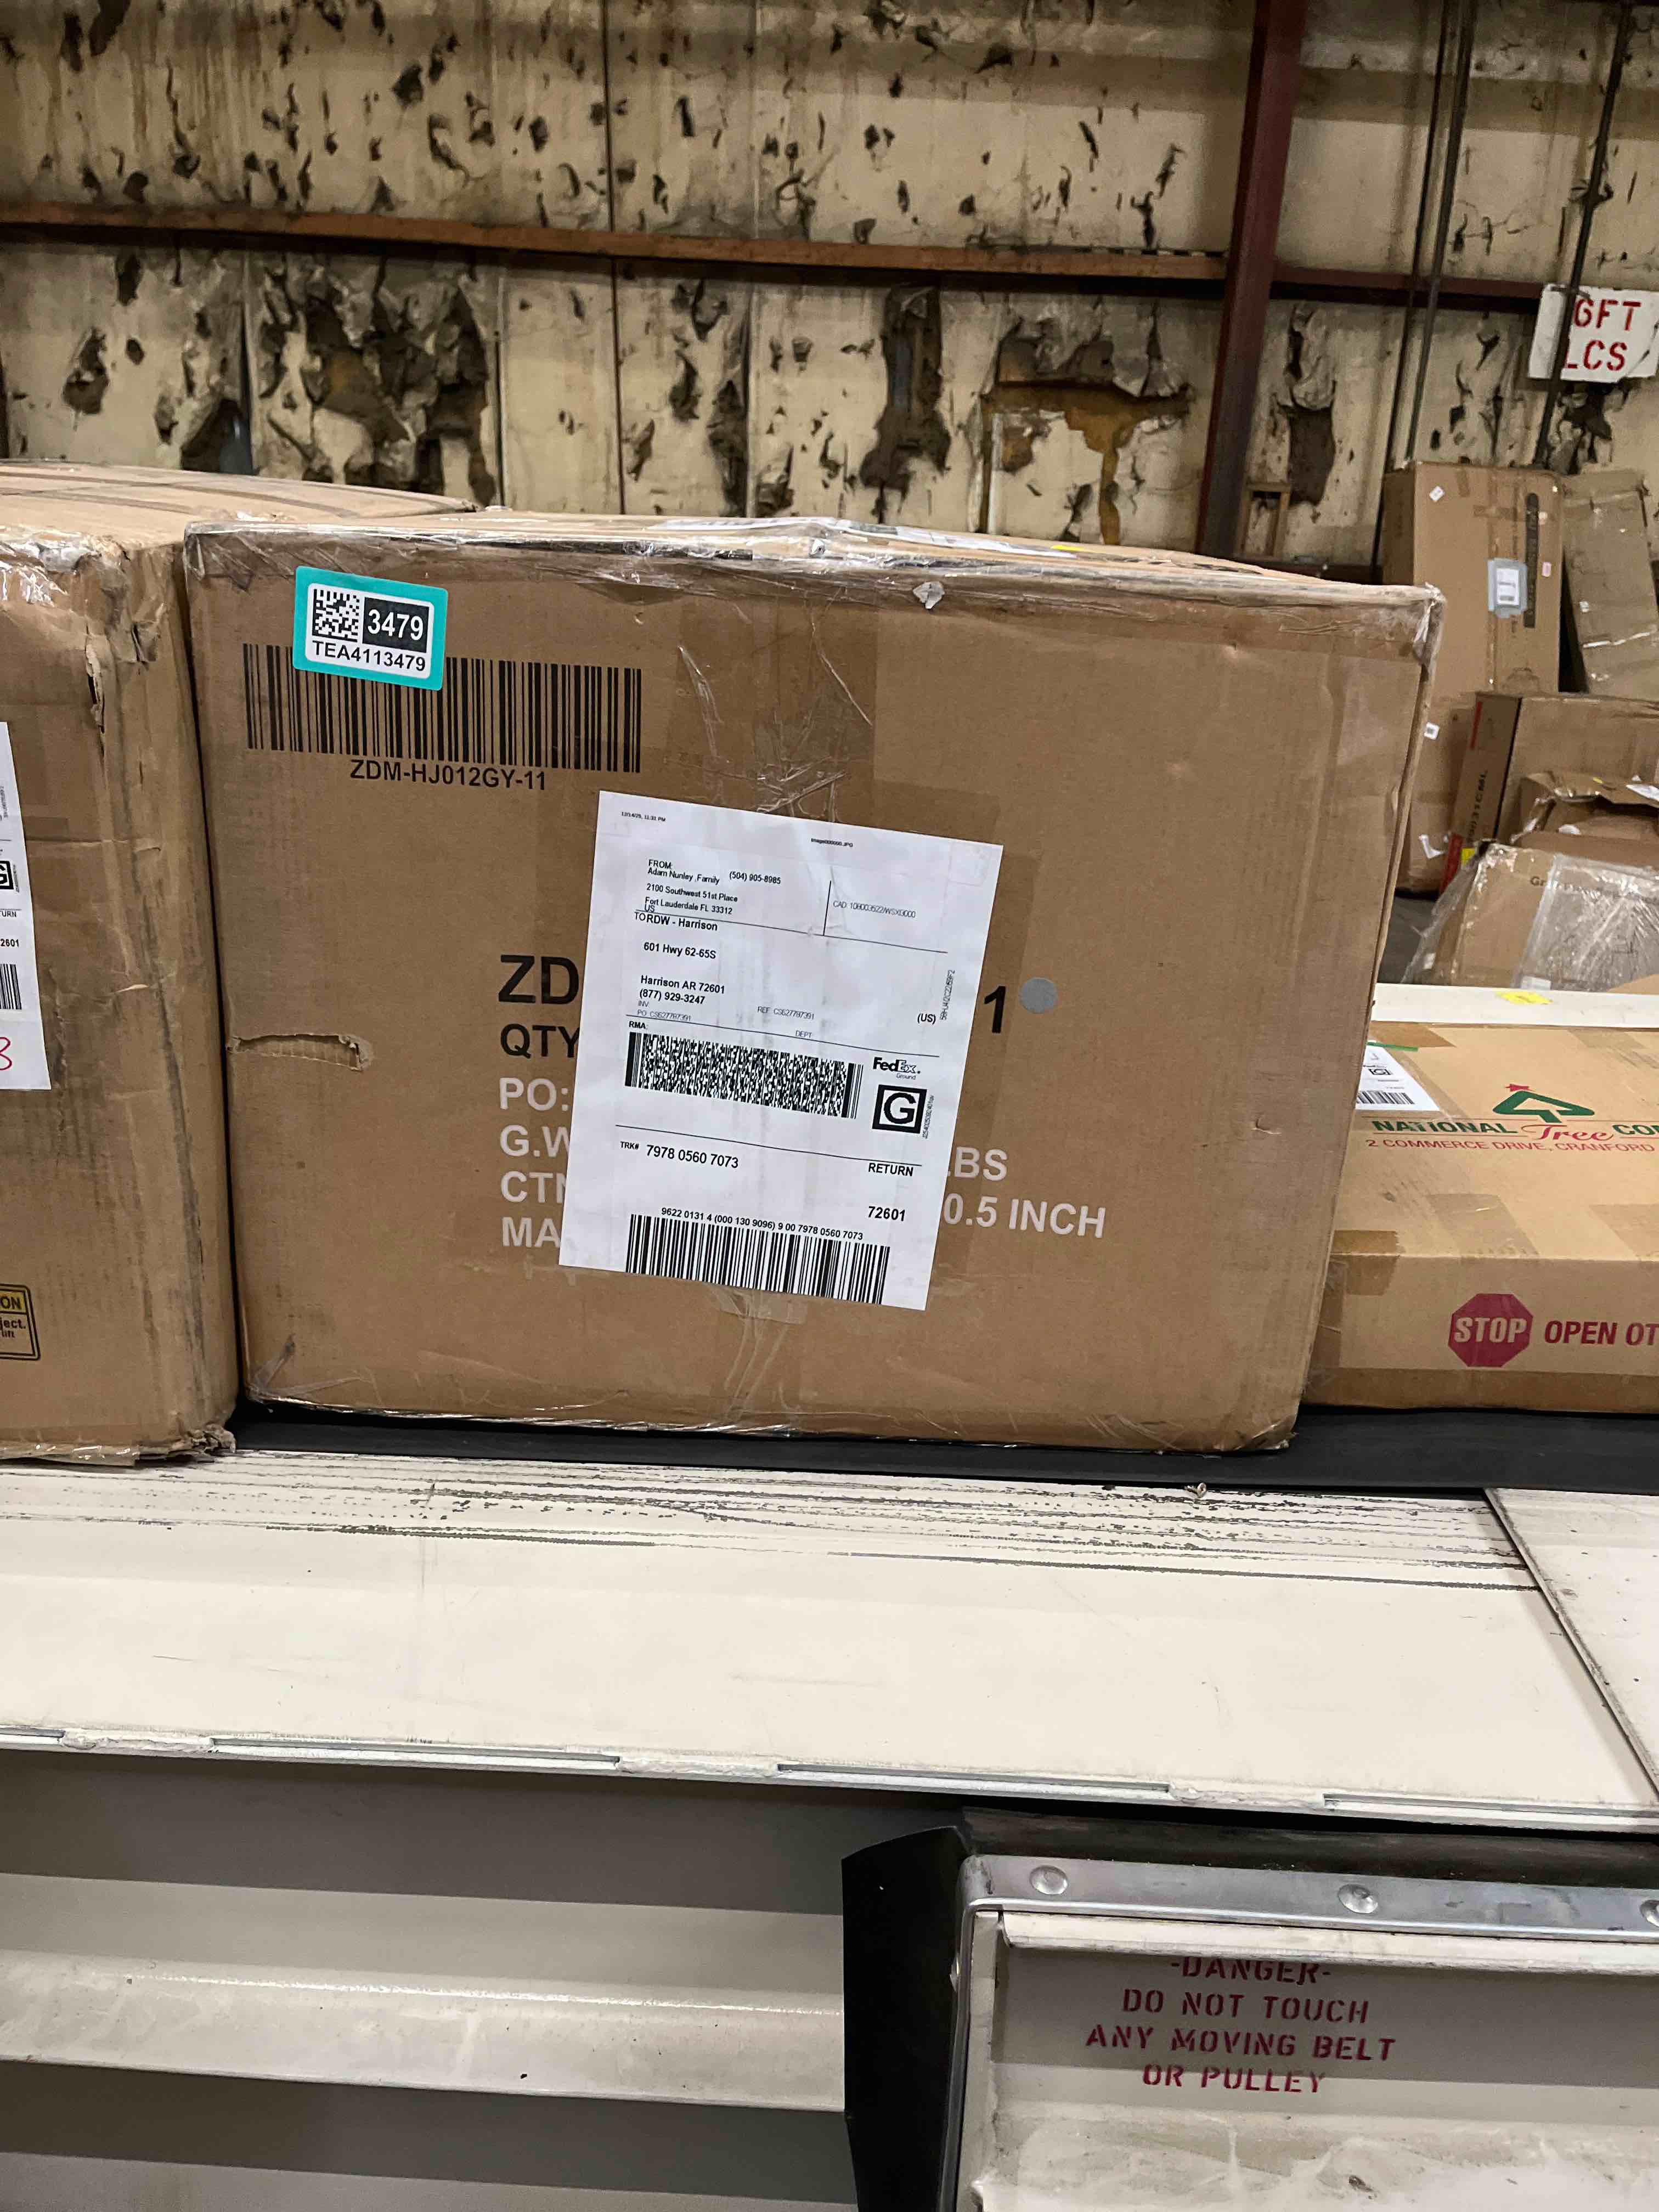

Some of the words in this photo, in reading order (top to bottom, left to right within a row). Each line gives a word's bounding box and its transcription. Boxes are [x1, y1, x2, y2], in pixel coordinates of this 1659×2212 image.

[368, 608, 425, 641] 3479
[313, 640, 426, 672] TEA4113479
[349, 759, 545, 791] ZDM-HJ012GY-11
[648, 867, 667, 877] Adam
[669, 871, 693, 882] Nunley
[729, 871, 747, 881] (504)
[749, 873, 781, 884] 905-8985
[646, 883, 663, 892] 2100
[665, 886, 701, 898] Southwest
[702, 891, 717, 900] 51st
[719, 893, 738, 902] Place
[644, 904, 655, 913] US
[645, 896, 659, 905] Fort
[661, 899, 698, 911] Lauderdale
[711, 905, 733, 915] 33312
[678, 918, 718, 931] Harrison
[644, 942, 659, 951] 601
[663, 944, 683, 957] Hwy
[685, 947, 716, 959] 62-65S
[641, 975, 679, 988] Harrison
[682, 980, 696, 990] AR
[699, 983, 725, 994] 72601
[640, 989, 662, 1001] (877)
[664, 992, 706, 1004] 929-3247
[917, 1013, 936, 1025] (US)
[499, 1077, 569, 1112] PO:
[884, 1092, 916, 1124] G
[1372, 1121, 1519, 1133] NATIONAL
[1521, 1124, 1614, 1141] Tree
[620, 1141, 639, 1150] TRK#
[647, 1144, 675, 1159] 7978
[678, 1149, 707, 1164] 0560
[710, 1154, 738, 1169] 7073
[1383, 1139, 1488, 1149] COMMERCE
[1492, 1141, 1553, 1152] DRIVE,
[1555, 1142, 1655, 1152] CRANFORD
[868, 1163, 913, 1176] RETURN
[948, 1146, 1008, 1182] BS
[661, 1207, 682, 1218] 9622
[684, 1211, 704, 1221] 0131
[714, 1215, 733, 1224] (000
[735, 1217, 751, 1226] 130
[752, 1219, 776, 1231] 9096)
[785, 1223, 796, 1232] 00
[798, 1224, 818, 1234] 7978
[820, 1228, 840, 1238] 0560
[843, 1230, 863, 1240] 7073
[868, 1206, 905, 1221] 72601
[1009, 1198, 1106, 1239] INCH
[1454, 1317, 1528, 1344] STOP
[1544, 1320, 1617, 1345] OPEN
[1122, 1988, 1164, 2013] DO
[1182, 1991, 1245, 2018] NOT
[1263, 1995, 1369, 2024] TOUCH
[1085, 2023, 1154, 2050] ANY
[1171, 2028, 1296, 2057] MOVING
[1312, 2035, 1397, 2062] BELT
[1142, 2063, 1186, 2087] OR
[1200, 2066, 1326, 2094] PULLEY
